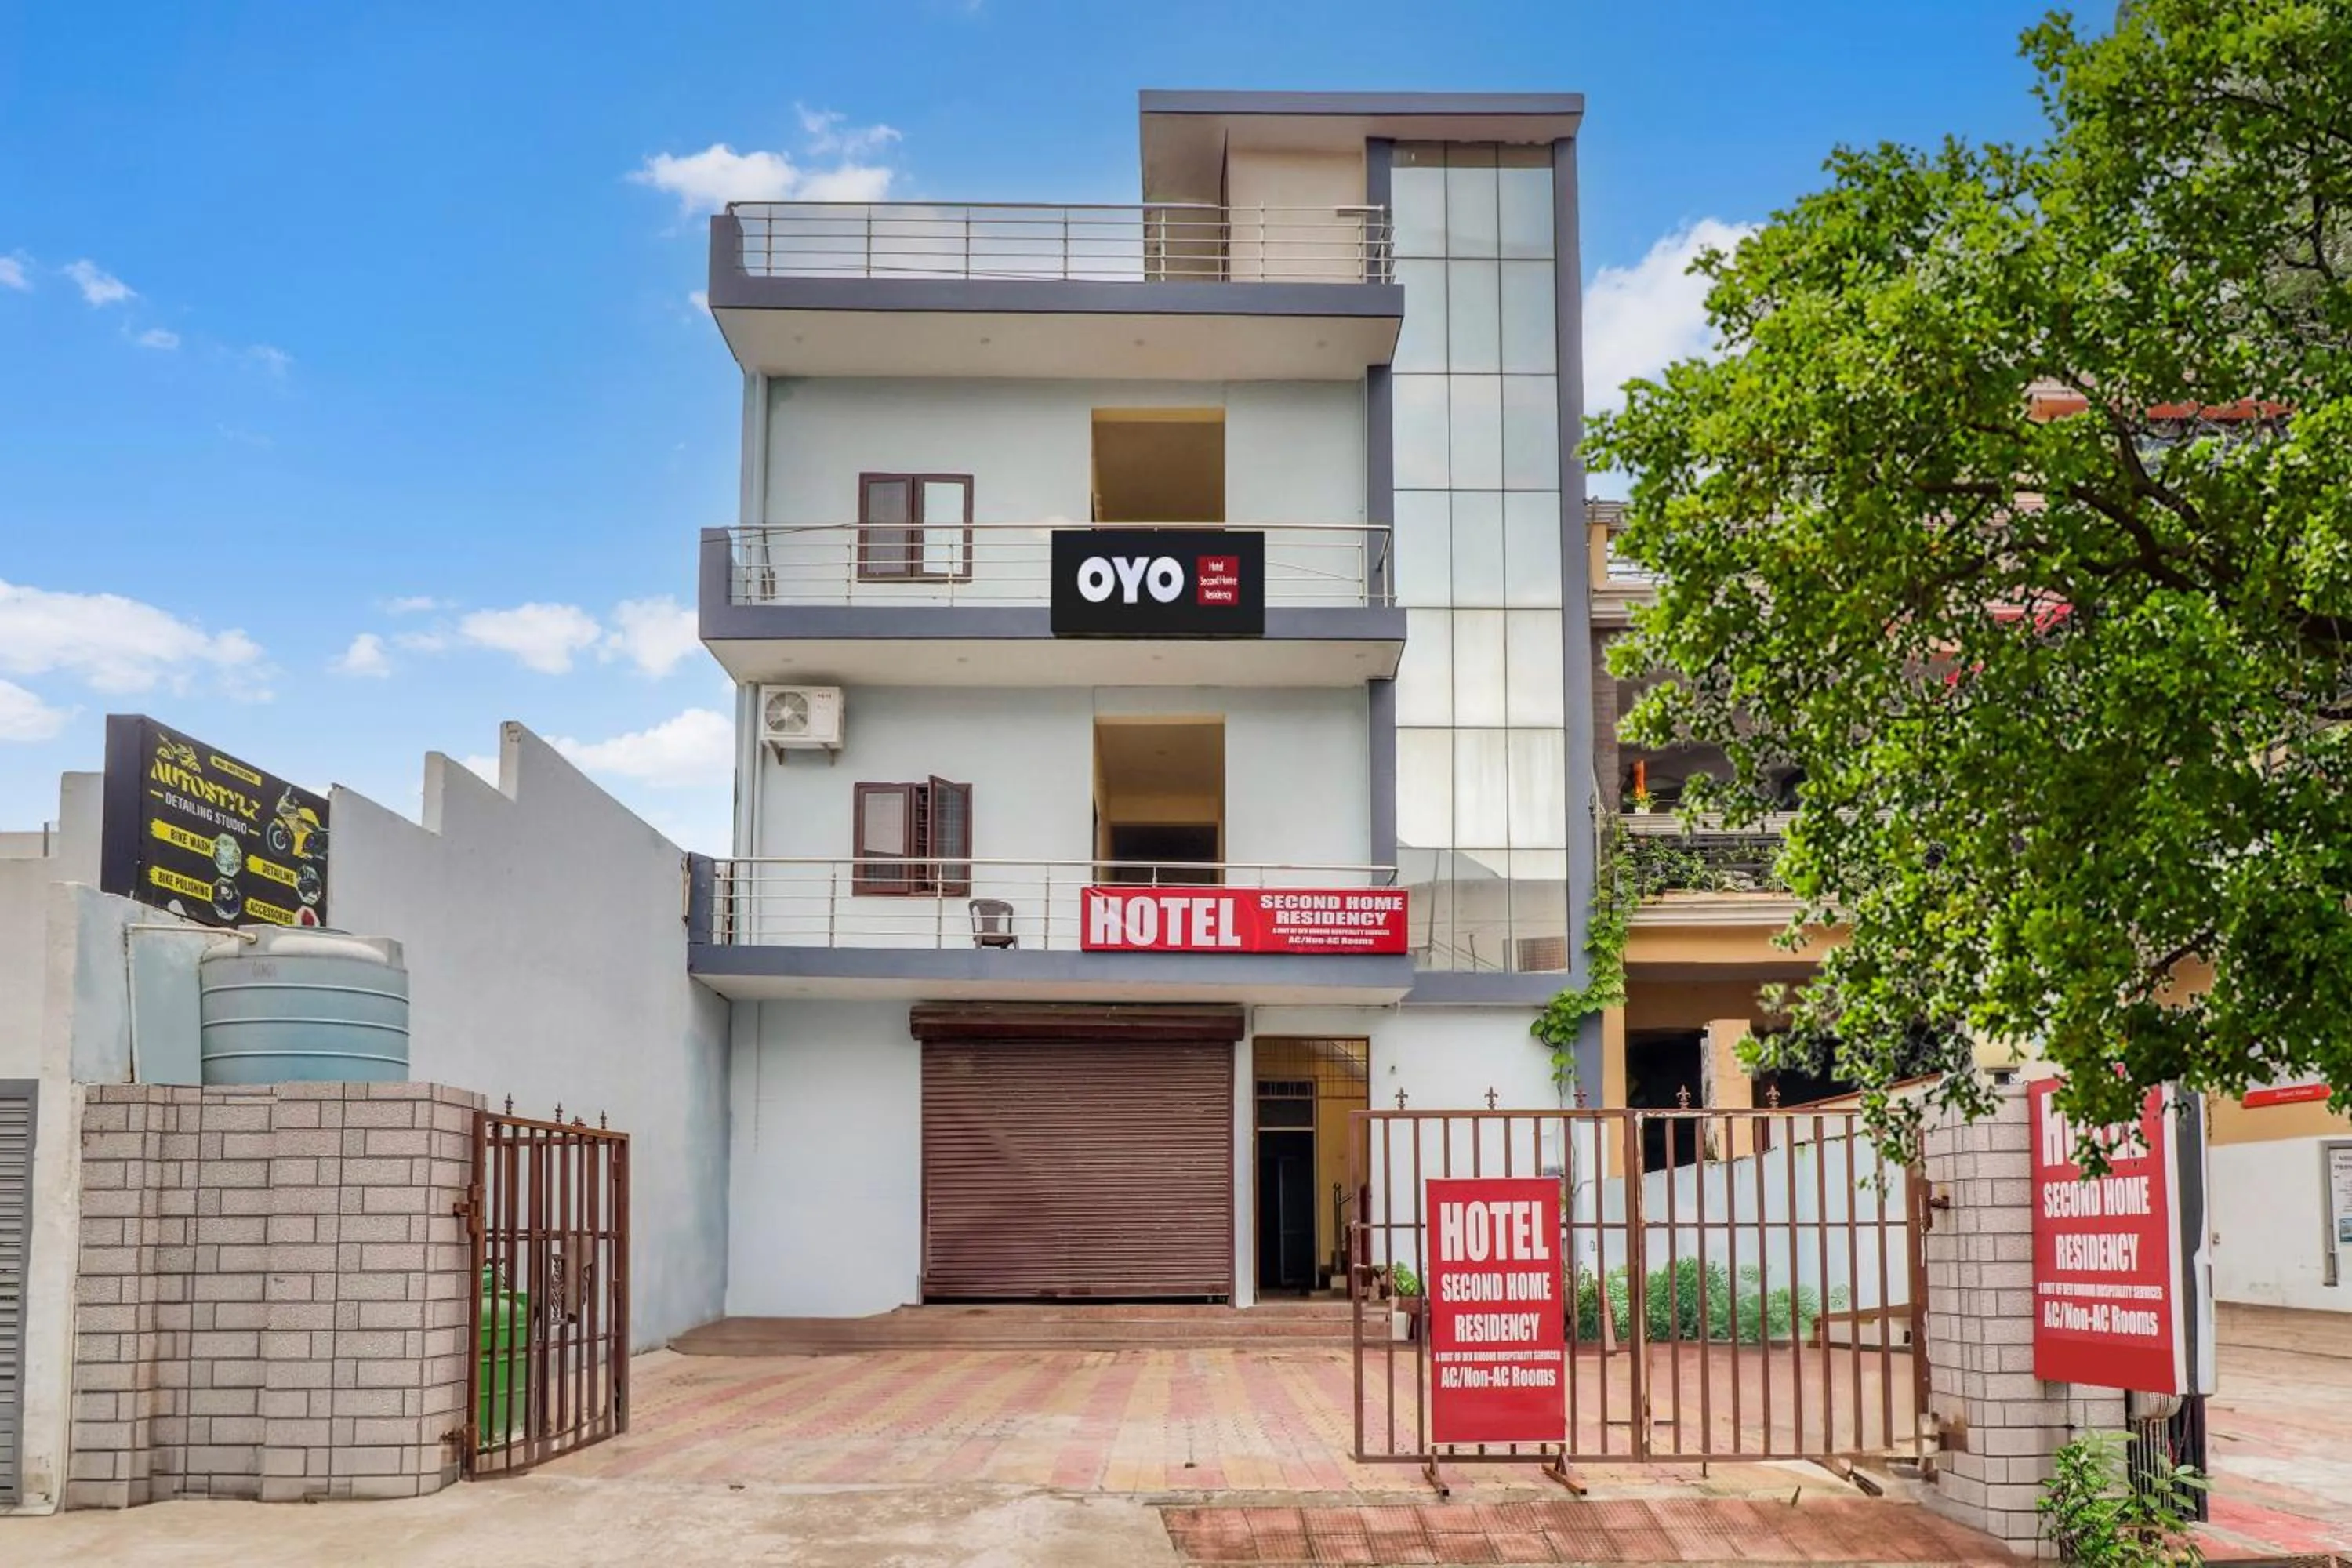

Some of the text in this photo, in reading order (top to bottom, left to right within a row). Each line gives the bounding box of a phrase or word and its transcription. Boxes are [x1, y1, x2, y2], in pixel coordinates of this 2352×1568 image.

[1208, 561, 1224, 572] Hotel
[1077, 556, 1185, 604] OYO
[1200, 575, 1237, 586] Second Home
[1204, 589, 1232, 601] Residency
[165, 791, 248, 835] DETAILING STUDIO
[170, 828, 211, 853] BIKE WASH
[158, 871, 209, 898] BIKE POLISHING
[262, 861, 295, 884] DETAILING
[249, 902, 293, 924] ACCESSORIES
[1260, 895, 1403, 910] SECOND HOME
[1089, 896, 1241, 946] HOTEL
[1276, 910, 1387, 926] RESIDENCY
[1288, 936, 1340, 945] AC/Non-AC
[2043, 1176, 2151, 1218] SECOND HOME
[1440, 1201, 1549, 1261] HOTEL
[2055, 1233, 2139, 1272] RESIDENCY
[1441, 1272, 1552, 1302] SECOND HOME
[1455, 1313, 1540, 1343] RESIDENCY
[2044, 1301, 2158, 1336] AC/Non-AC Rooms
[1441, 1366, 1556, 1388] AC/Non-AC Rooms
